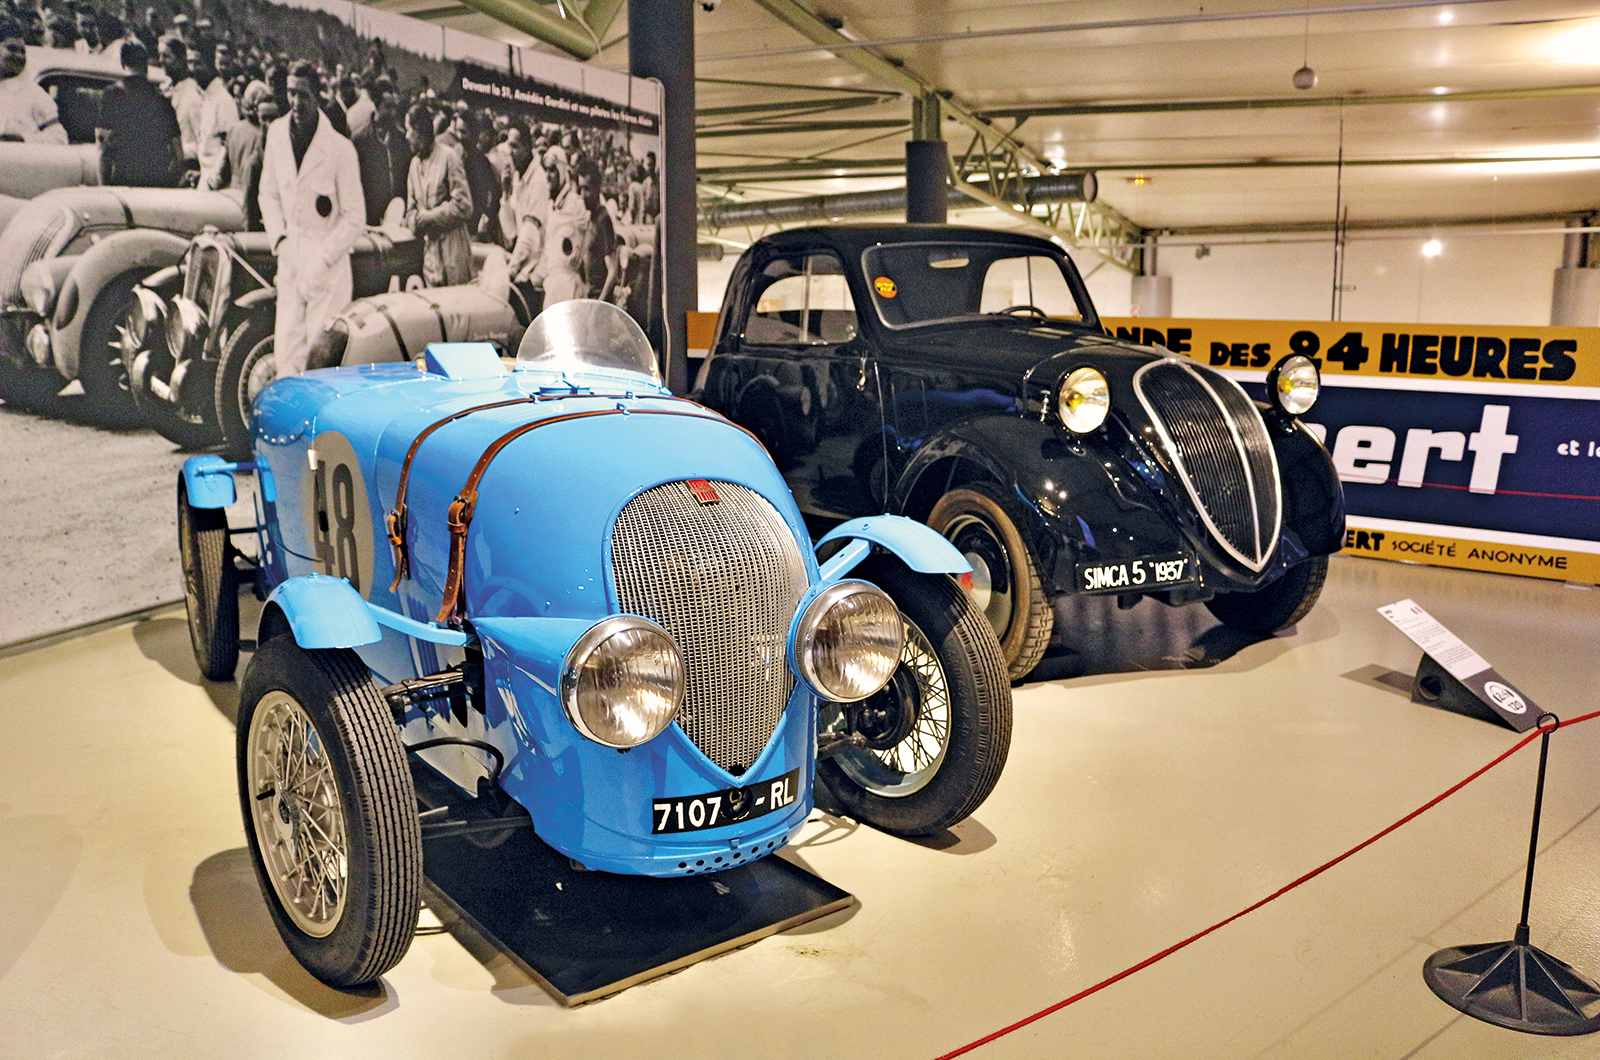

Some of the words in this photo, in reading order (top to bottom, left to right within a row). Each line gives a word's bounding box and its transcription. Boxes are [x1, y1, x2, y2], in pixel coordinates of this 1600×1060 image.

[462, 77, 491, 94] Devant
[1209, 341, 1271, 367] DES
[1289, 330, 1369, 371] 24
[1379, 333, 1578, 382] HEURES
[1304, 404, 1519, 495] ert
[1557, 439, 1580, 456] et
[1392, 540, 1457, 557] SOCIÉTÉ
[1468, 549, 1568, 570] ANONYME
[1084, 564, 1129, 590] SIMCA
[1132, 560, 1146, 584] 5
[653, 797, 722, 832] 7107
